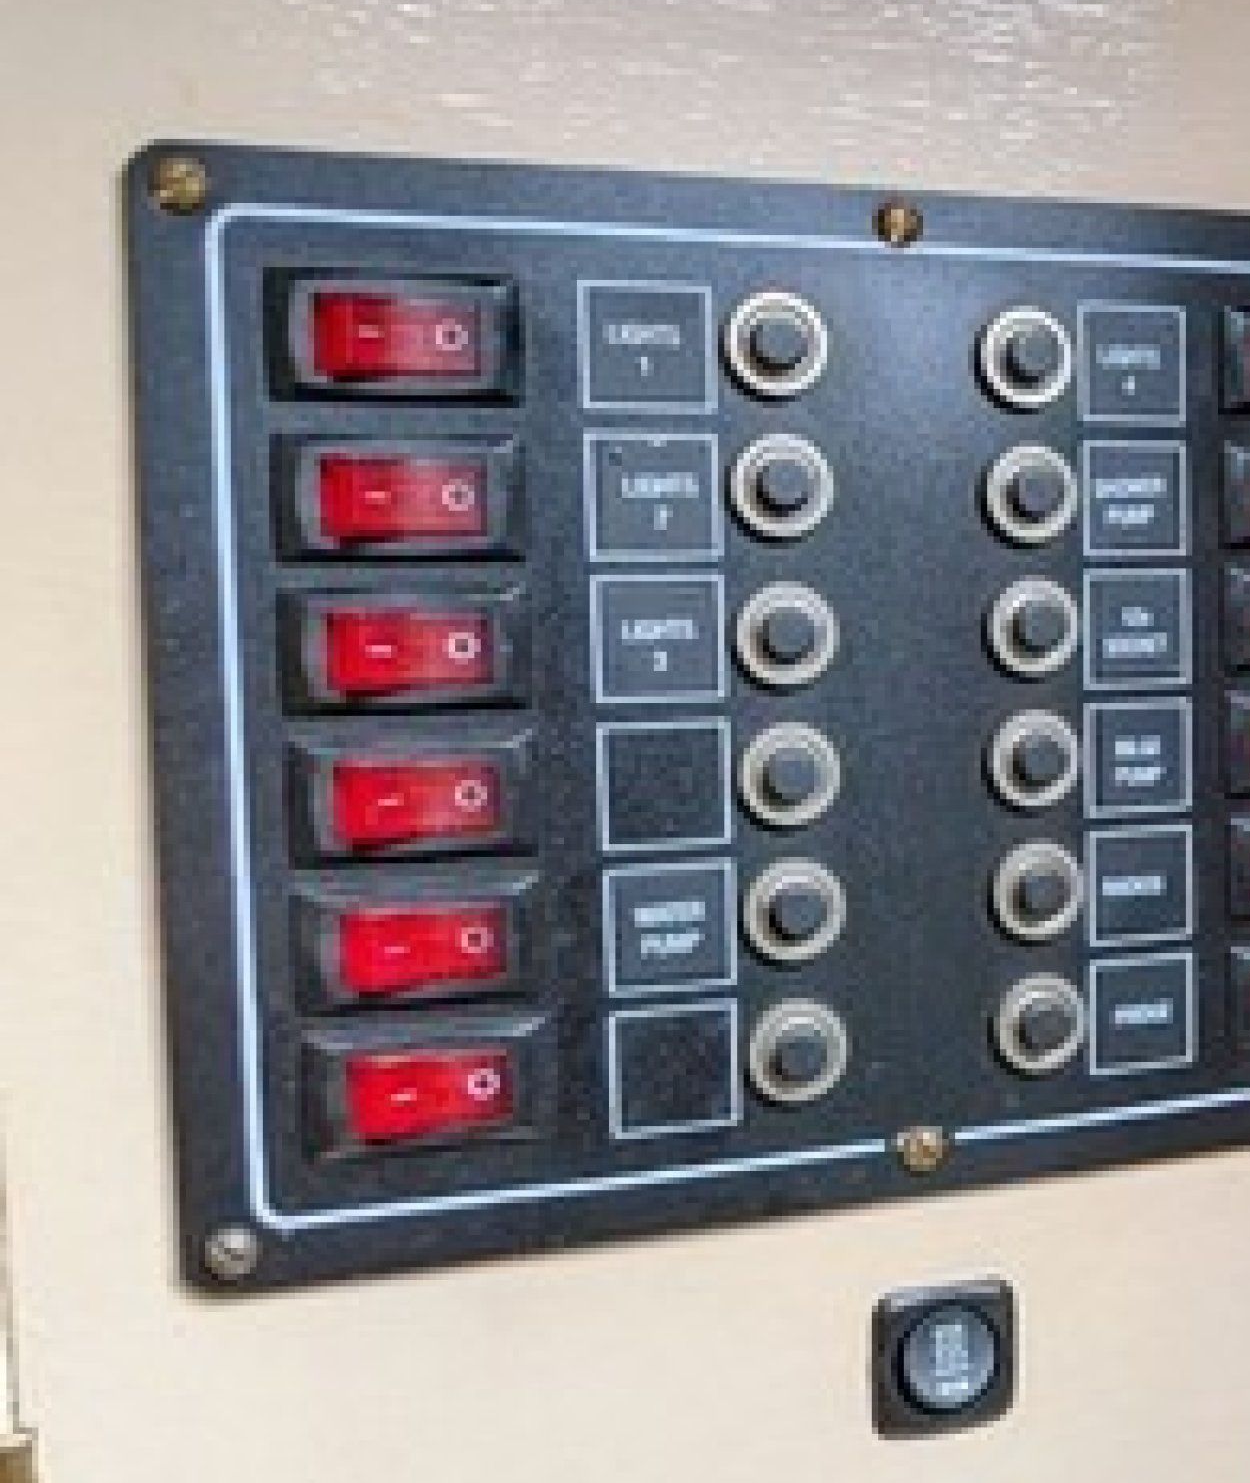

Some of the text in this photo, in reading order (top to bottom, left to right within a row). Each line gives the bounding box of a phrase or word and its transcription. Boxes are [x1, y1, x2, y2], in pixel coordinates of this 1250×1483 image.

[604, 321, 682, 349] LIGHTS
[620, 470, 700, 500] LIGHTS
[620, 618, 700, 646] LIGHTS
